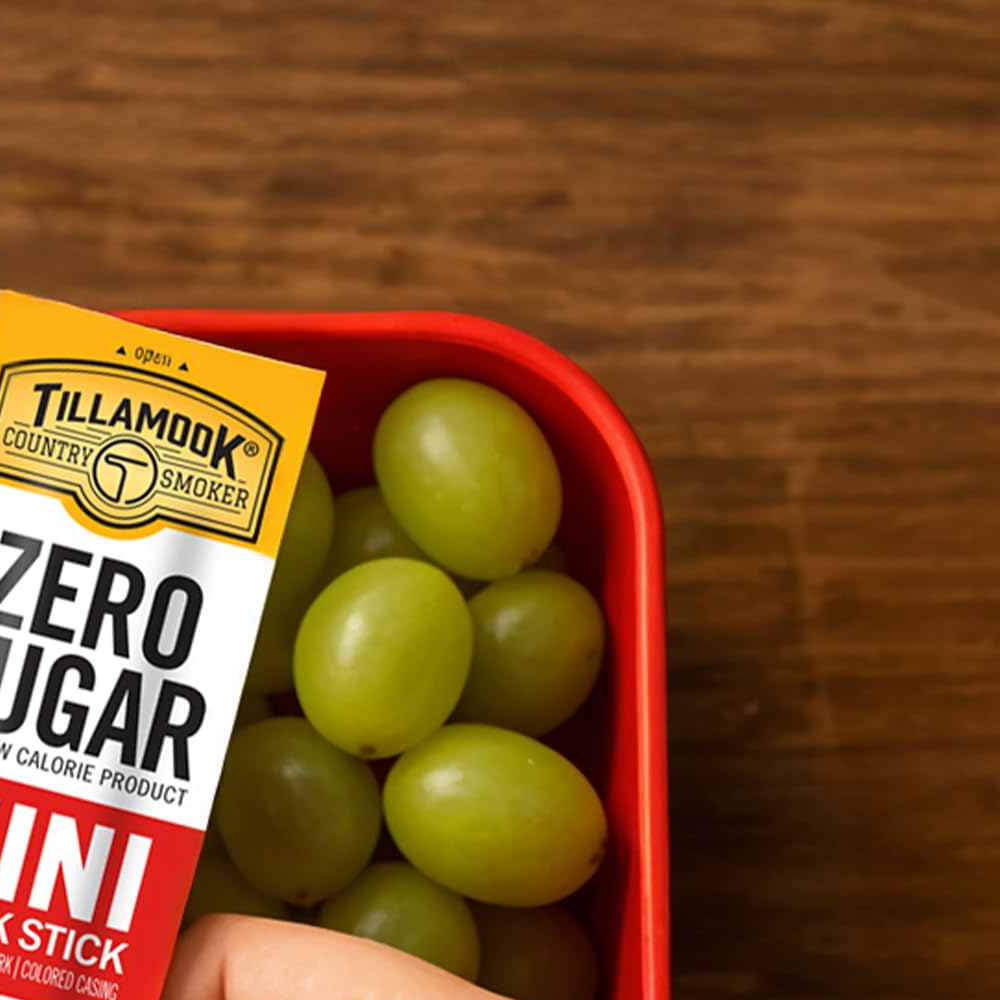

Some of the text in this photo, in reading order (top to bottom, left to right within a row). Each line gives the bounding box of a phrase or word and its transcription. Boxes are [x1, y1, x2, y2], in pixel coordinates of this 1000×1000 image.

[3, 426, 249, 509] COUNTRY SMOKER
[16, 747, 96, 784] CALORIE
[99, 768, 189, 806] PRODUCT
[17, 918, 129, 975] STICK
[21, 959, 74, 991] COLORED
